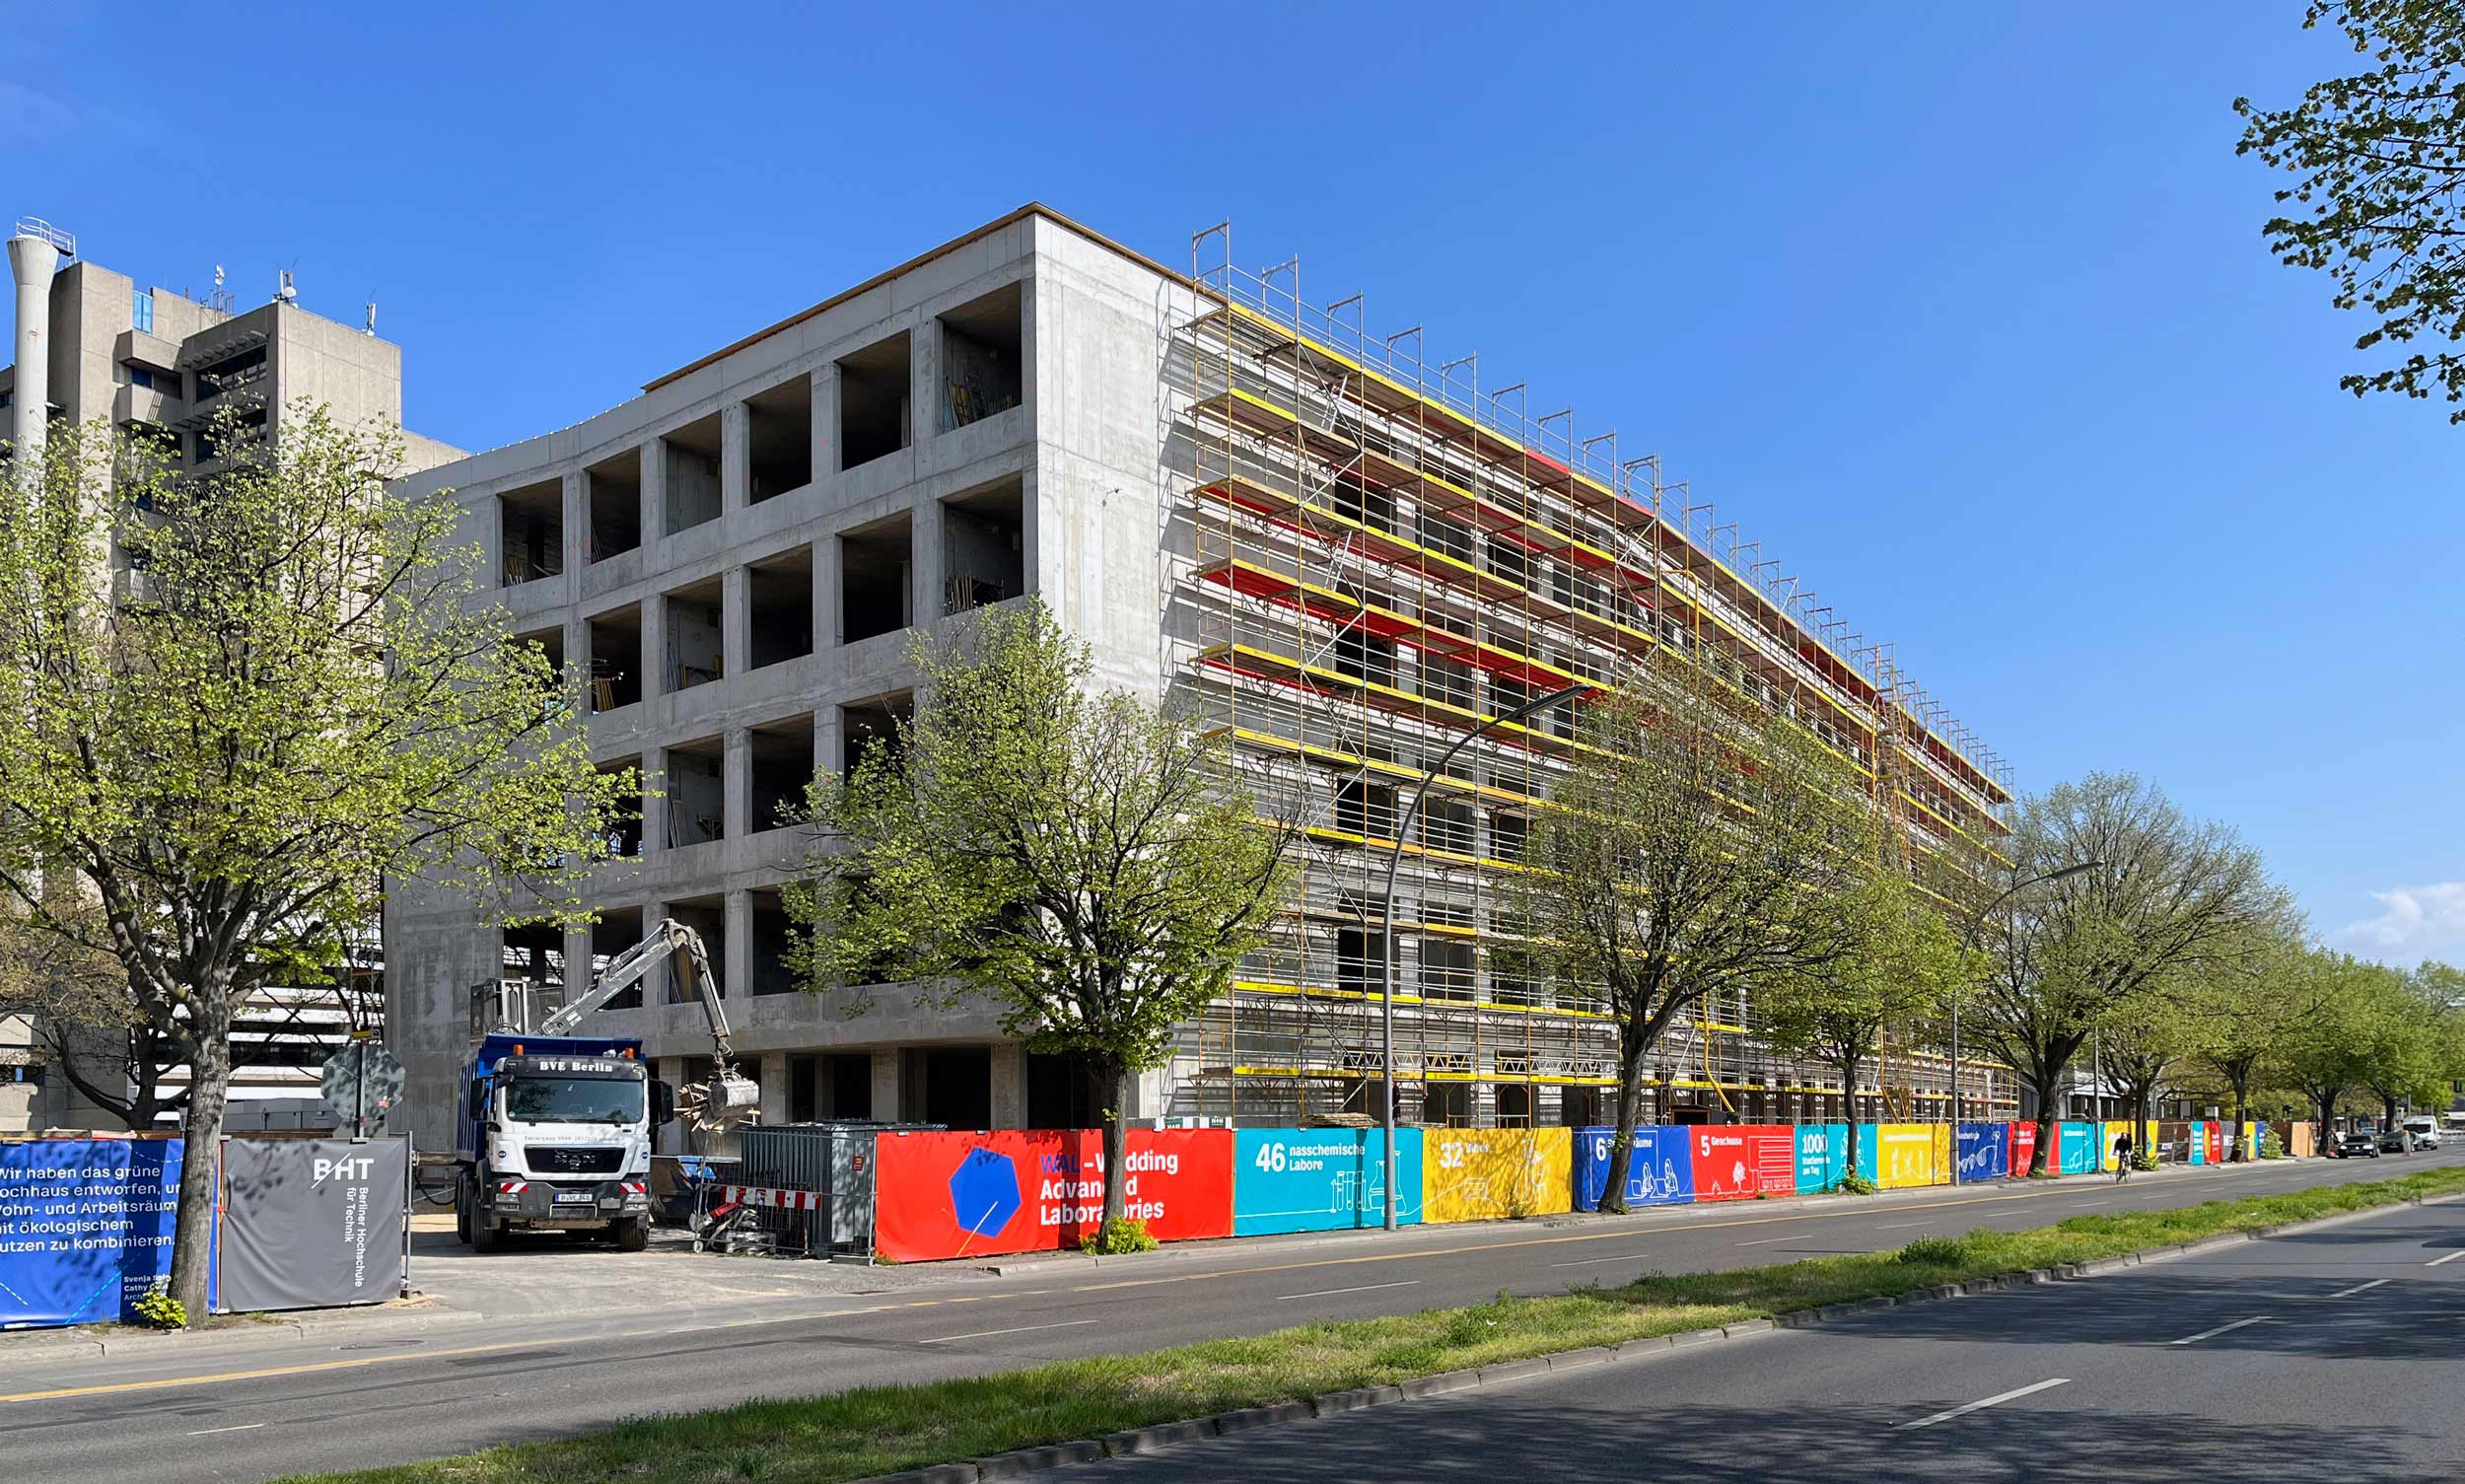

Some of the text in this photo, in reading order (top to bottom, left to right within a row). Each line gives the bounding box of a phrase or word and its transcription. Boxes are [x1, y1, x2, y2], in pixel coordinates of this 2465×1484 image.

[539, 1061, 613, 1073] BVE Berlin
[1440, 1141, 1465, 1168] 32
[1595, 1137, 1607, 1162] 6
[1701, 1135, 1711, 1157] 5
[1801, 1133, 1829, 1154] 1000
[1040, 1154, 1080, 1174] WAL
[1094, 1150, 1178, 1175] Wdding
[1255, 1142, 1366, 1172] 46 nasschemische
[1290, 1159, 1323, 1171] Labore
[0, 1166, 161, 1181] Wir haben das grüne
[0, 1185, 69, 1198] ochhaus
[74, 1183, 161, 1197] entworfen,
[1040, 1175, 1138, 1200] Advand
[0, 1200, 177, 1217] ohn- und Arbeitsräum
[344, 1186, 357, 1242] für Technik
[1040, 1198, 1164, 1226] Laboraries
[0, 1219, 134, 1235] it ökologischem
[354, 1187, 369, 1288] Berliner Hochschule
[0, 1236, 176, 1253] utzen zu kombinieren.
